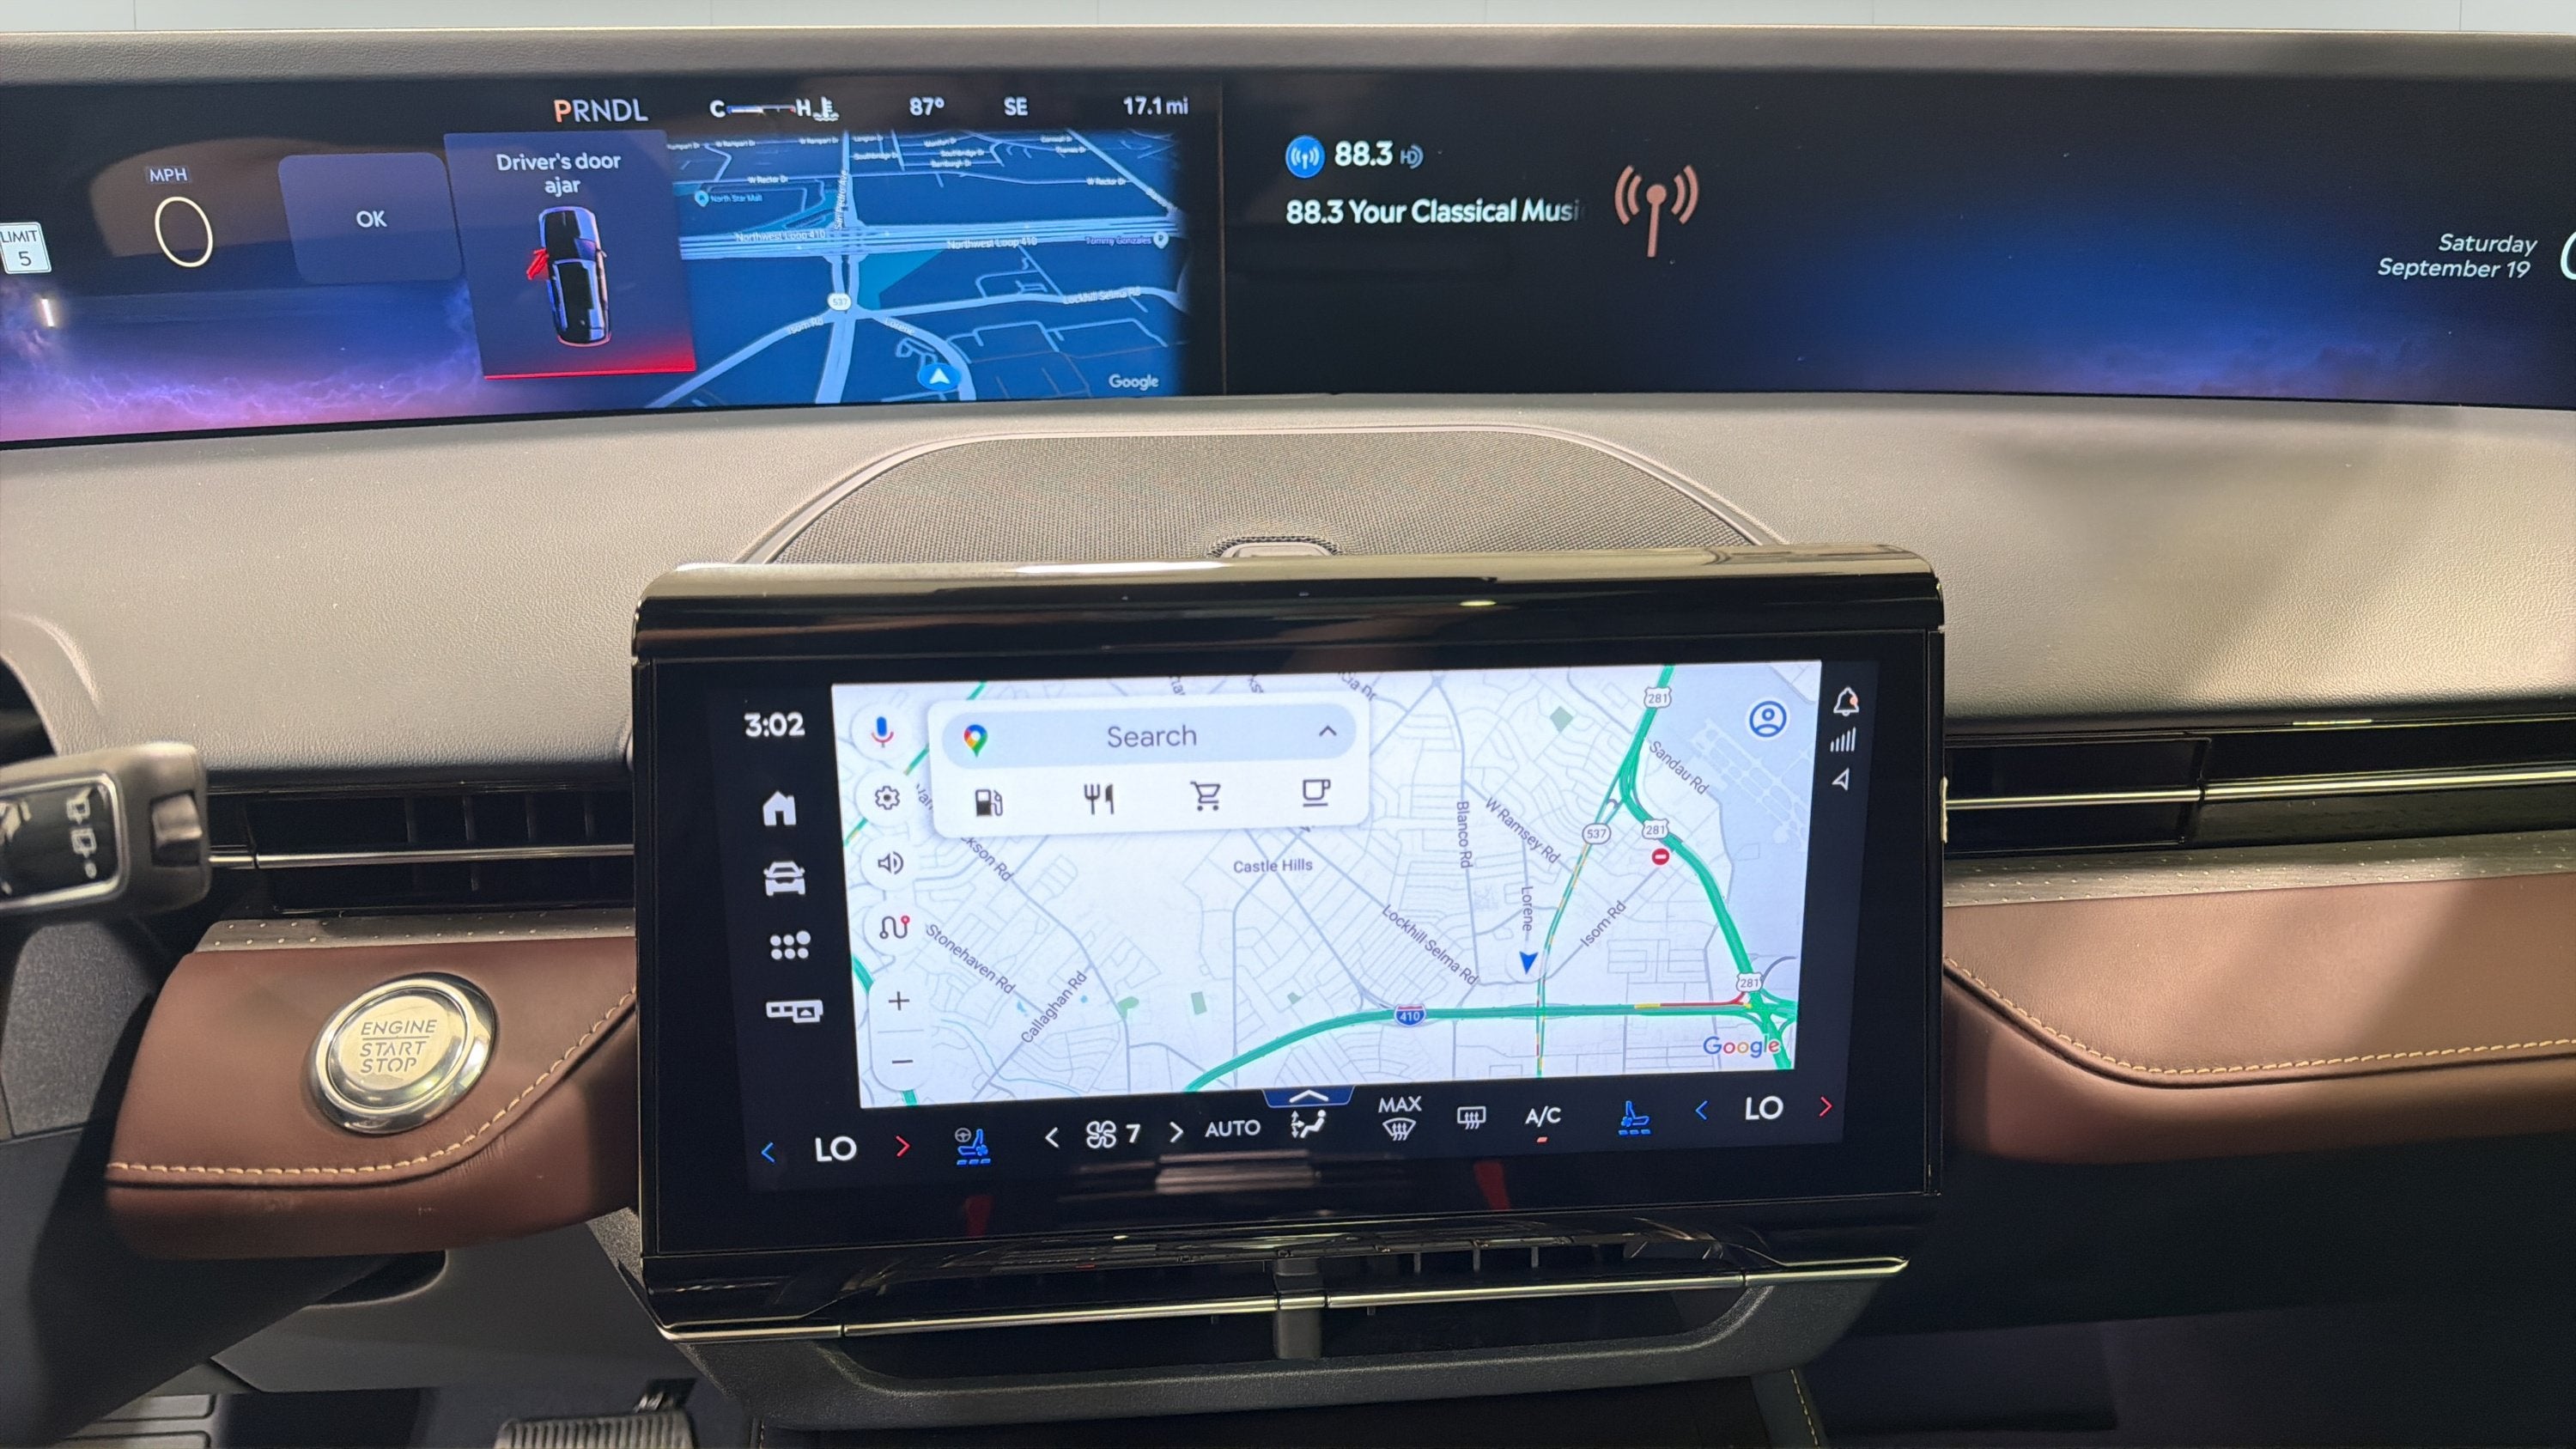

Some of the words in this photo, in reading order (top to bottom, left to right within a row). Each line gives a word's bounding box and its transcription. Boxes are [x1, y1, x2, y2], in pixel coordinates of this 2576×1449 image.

[554, 98, 648, 123] PRNDL
[709, 100, 726, 118] C
[796, 98, 811, 117] H
[1004, 96, 1028, 116] SE
[1124, 95, 1162, 115] 17.1
[1166, 96, 1188, 115] mi
[496, 153, 572, 171] Driver's
[577, 152, 621, 170] door
[1334, 141, 1393, 167] 88.3
[149, 167, 188, 183] MPH
[544, 177, 580, 197] ajar
[355, 210, 387, 228] OK
[1286, 198, 1344, 224] 88.3
[1348, 198, 1407, 224] Your
[1411, 198, 1516, 224] Classical
[1521, 197, 1585, 222] Musi
[0, 230, 37, 243] LIMIT
[735, 231, 782, 242] Northwest
[809, 229, 826, 240] 410
[947, 237, 993, 250] Northwest
[995, 236, 1019, 249] Loop
[2438, 233, 2538, 257] Saturday
[18, 251, 32, 266] 5
[2378, 258, 2500, 280] September
[2506, 260, 2531, 278] 19
[1109, 373, 1159, 391] Google
[1648, 693, 1668, 704] 281
[744, 711, 805, 738] 3:02
[1107, 725, 1197, 748] Search
[1649, 740, 1693, 782] Sandau
[1690, 775, 1710, 795] Rd
[1456, 801, 1470, 848] Blanco
[1485, 797, 1501, 813] W
[1497, 809, 1543, 851] Ramsey
[1542, 846, 1561, 865] Rd
[1587, 828, 1607, 838] 537
[1646, 825, 1665, 835] 281
[1233, 859, 1278, 874] Castle
[1282, 858, 1313, 872] Hills
[1460, 851, 1473, 869] Rd
[993, 861, 1014, 882] Rd
[1522, 886, 1534, 932] Lorene
[1580, 917, 1612, 947] Isom
[1607, 900, 1626, 921] Rd
[1382, 904, 1427, 945] Lockhill
[1425, 939, 1460, 972] Selma
[1460, 966, 1479, 985] Rd
[926, 923, 998, 979] Stonehaven
[994, 972, 1017, 995] Rd
[1740, 977, 1759, 988] 281
[1021, 984, 1075, 1044] Callaghan
[1068, 970, 1088, 992] Rd
[1400, 1011, 1420, 1021] 410
[361, 1020, 437, 1036] ENGINE
[360, 1040, 427, 1057] START
[1703, 1034, 1780, 1058] Google
[361, 1057, 417, 1074] STOP
[1378, 1096, 1422, 1113] MAX
[1745, 1096, 1784, 1120] LO
[1525, 1105, 1561, 1127] A/C
[1125, 1123, 1141, 1145] 7
[1205, 1120, 1261, 1139] AUTO
[815, 1135, 858, 1163] LO
